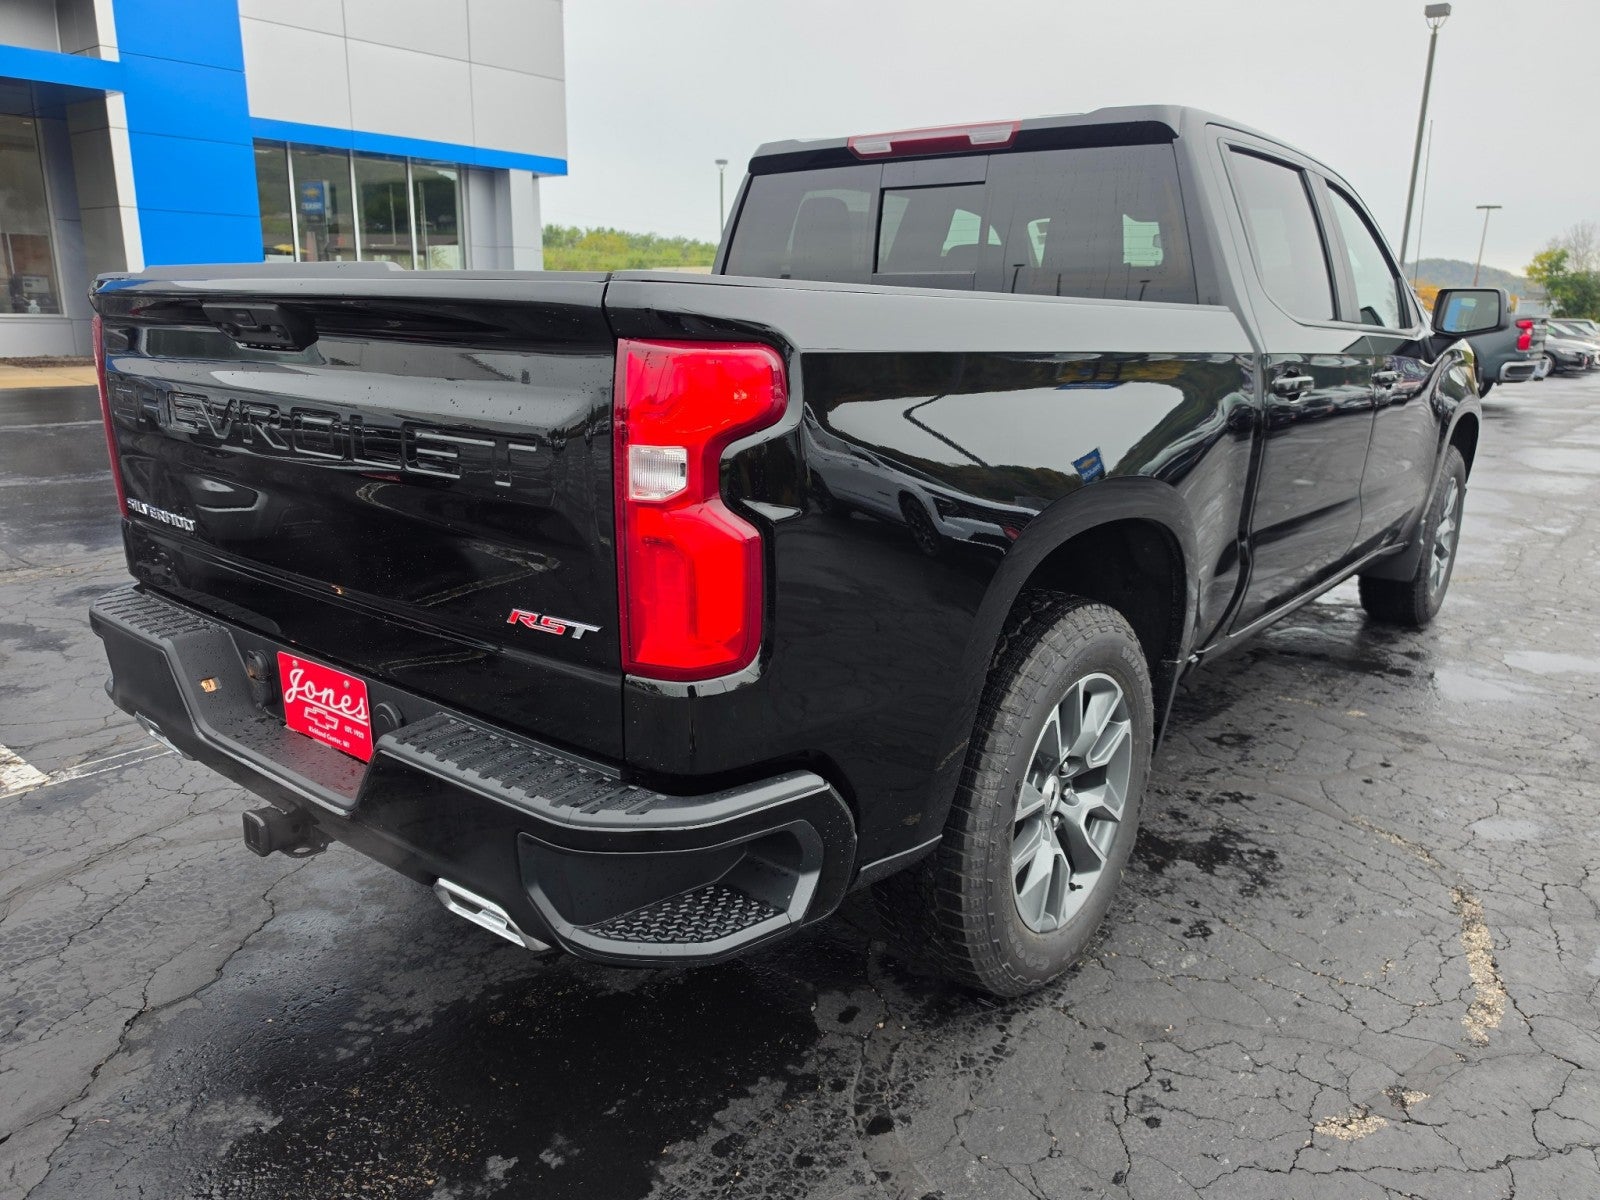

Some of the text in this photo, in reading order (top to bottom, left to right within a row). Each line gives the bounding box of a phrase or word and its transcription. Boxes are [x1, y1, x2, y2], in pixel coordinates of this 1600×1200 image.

[126, 497, 196, 532] SILVERADO
[507, 608, 602, 640] RST
[285, 668, 368, 719] Jones
